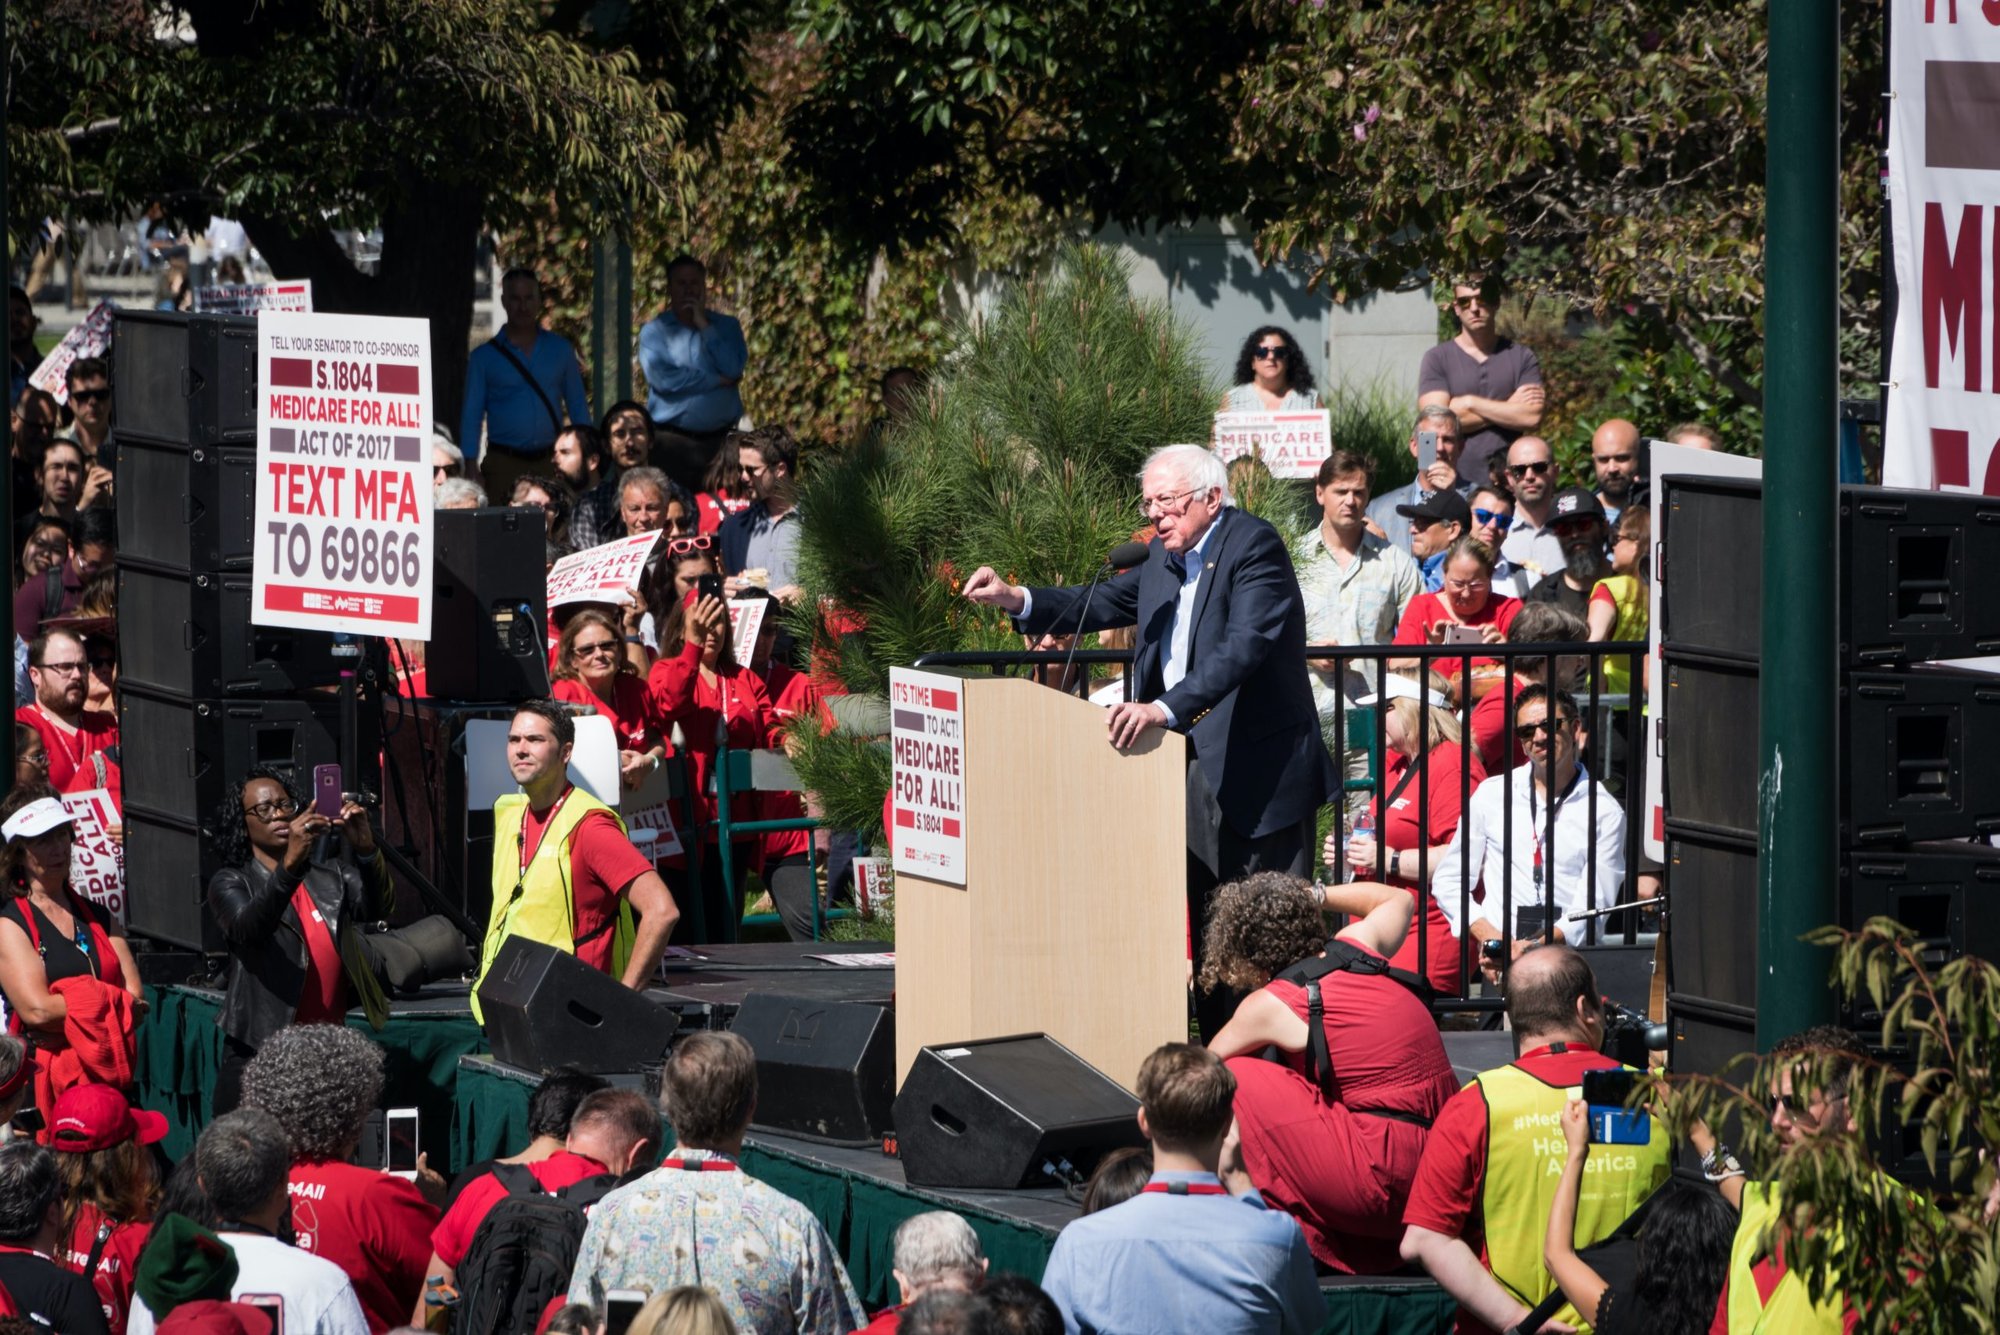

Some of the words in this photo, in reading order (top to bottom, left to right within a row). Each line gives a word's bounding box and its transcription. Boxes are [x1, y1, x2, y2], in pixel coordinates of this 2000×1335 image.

[271, 336, 290, 350] TELL
[291, 338, 313, 352] YOUR
[314, 339, 351, 354] SENATOR
[353, 340, 364, 354] TO
[365, 341, 420, 357] CO-SPONSOR
[316, 360, 373, 392] S.1804
[270, 394, 347, 424] MEDICARE
[351, 399, 382, 426] FOR
[386, 401, 420, 429] ALL!
[298, 429, 329, 456] ACT
[332, 431, 353, 458] OF
[356, 434, 391, 461] 2017
[1221, 431, 1324, 445] MEDICARE
[1277, 446, 1325, 458] ALL!
[268, 462, 346, 518] TEXT
[355, 468, 420, 525] MFA
[268, 521, 312, 578] TO
[321, 525, 420, 588] 69866
[547, 551, 645, 585] MEDICARE
[548, 577, 577, 594] OR
[585, 565, 638, 583] ALL!
[739, 605, 762, 664] HEALTHC
[892, 681, 909, 704] IT'S
[909, 684, 930, 708] TIME
[926, 714, 938, 735] TO
[940, 717, 959, 739] ACT!
[894, 735, 960, 777] MEDICARE
[895, 770, 923, 805] FOR
[930, 778, 960, 813] ALL!
[634, 810, 670, 831] ALL!
[916, 812, 942, 835] S.1804
[103, 873, 122, 914] OR
[1546, 1152, 1637, 1177] Aerica
